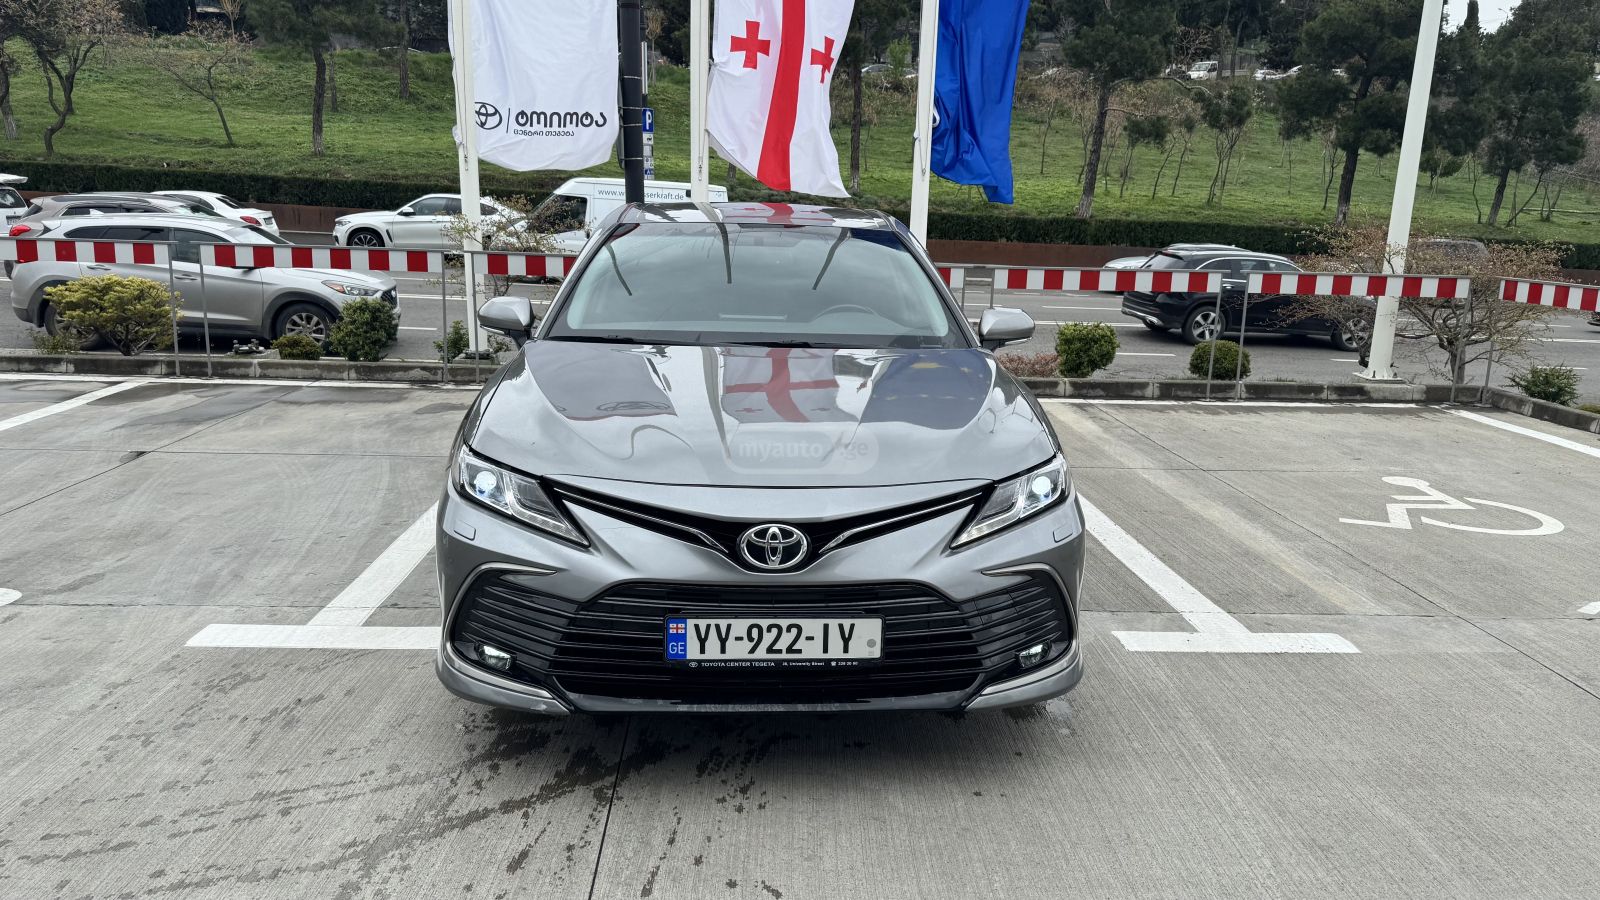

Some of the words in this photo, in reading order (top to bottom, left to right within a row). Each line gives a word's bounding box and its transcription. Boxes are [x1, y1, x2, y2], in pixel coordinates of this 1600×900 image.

[515, 110, 607, 128] ტოიოტა
[645, 110, 653, 130] P
[669, 642, 685, 654] GE
[694, 623, 855, 655] YY-922-IY
